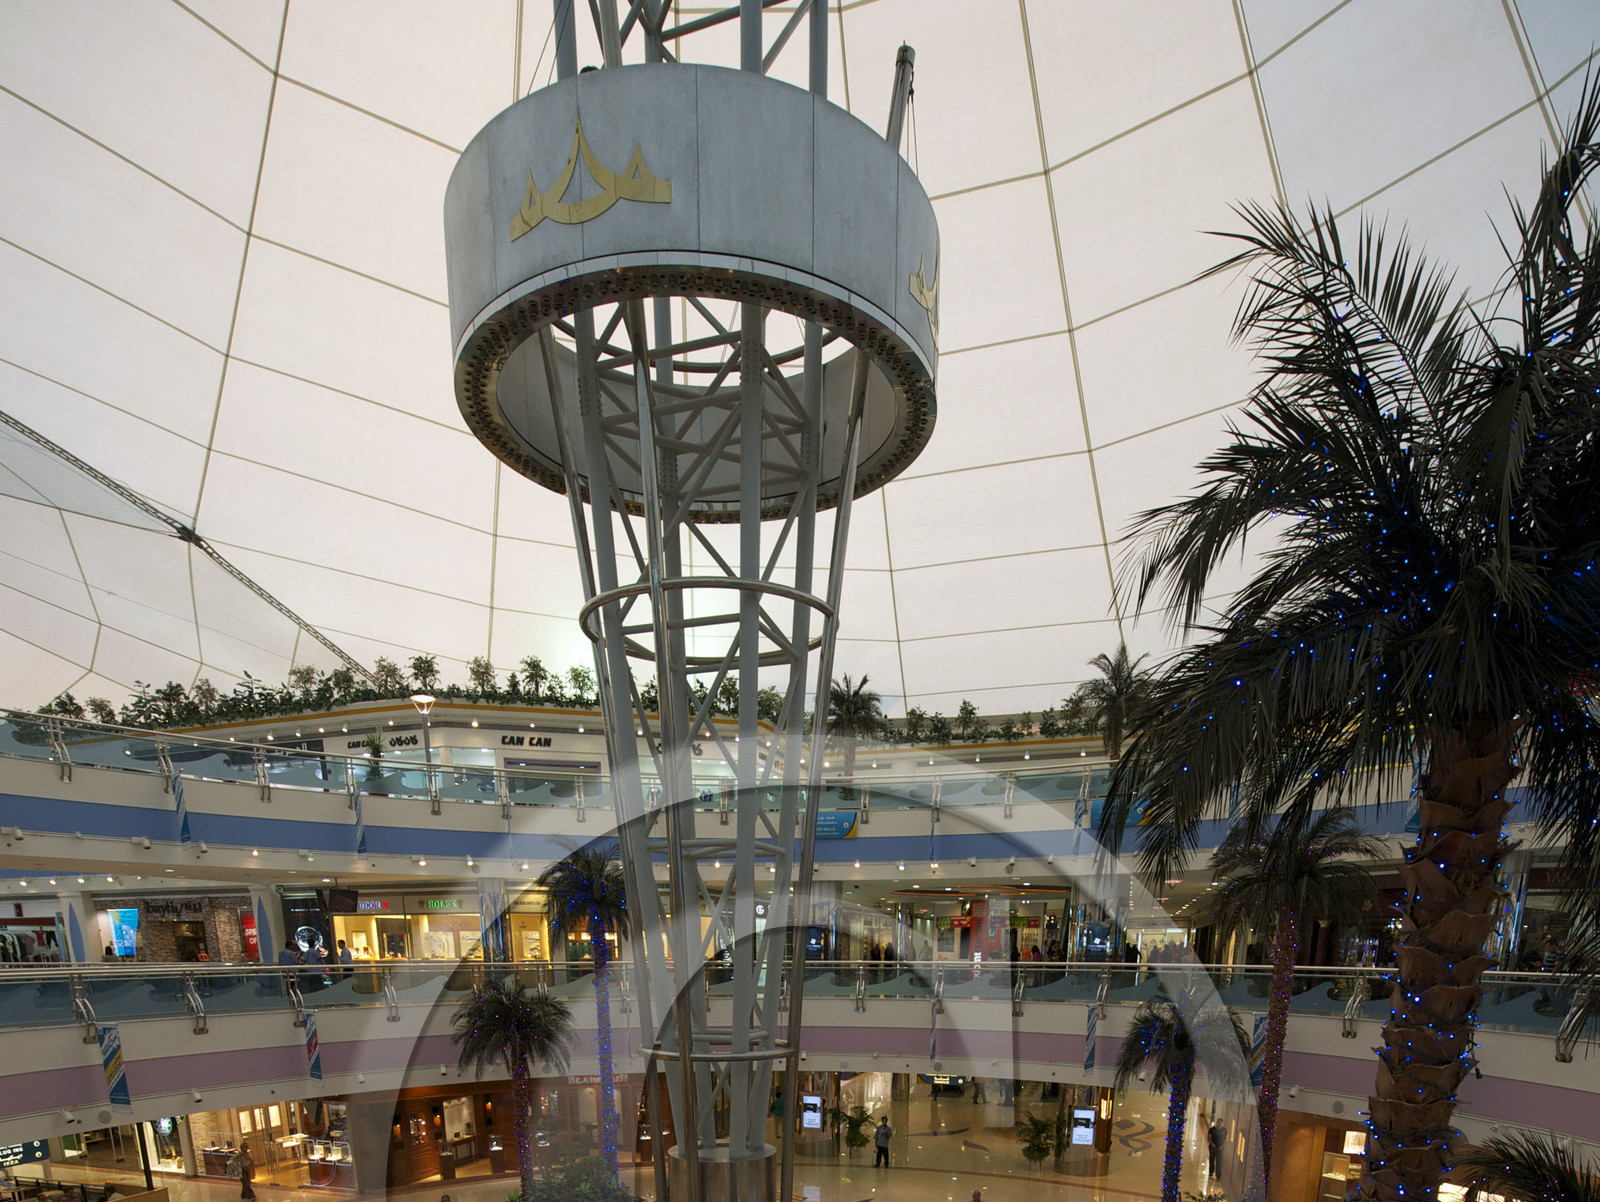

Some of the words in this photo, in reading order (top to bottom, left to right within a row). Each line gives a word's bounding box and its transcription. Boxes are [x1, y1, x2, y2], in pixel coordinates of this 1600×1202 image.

[501, 735, 525, 746] CAN
[528, 736, 552, 747] CAN
[358, 900, 381, 910] UDOR
[427, 900, 458, 909] ROLEX
[3, 1159, 19, 1167] IKEA
